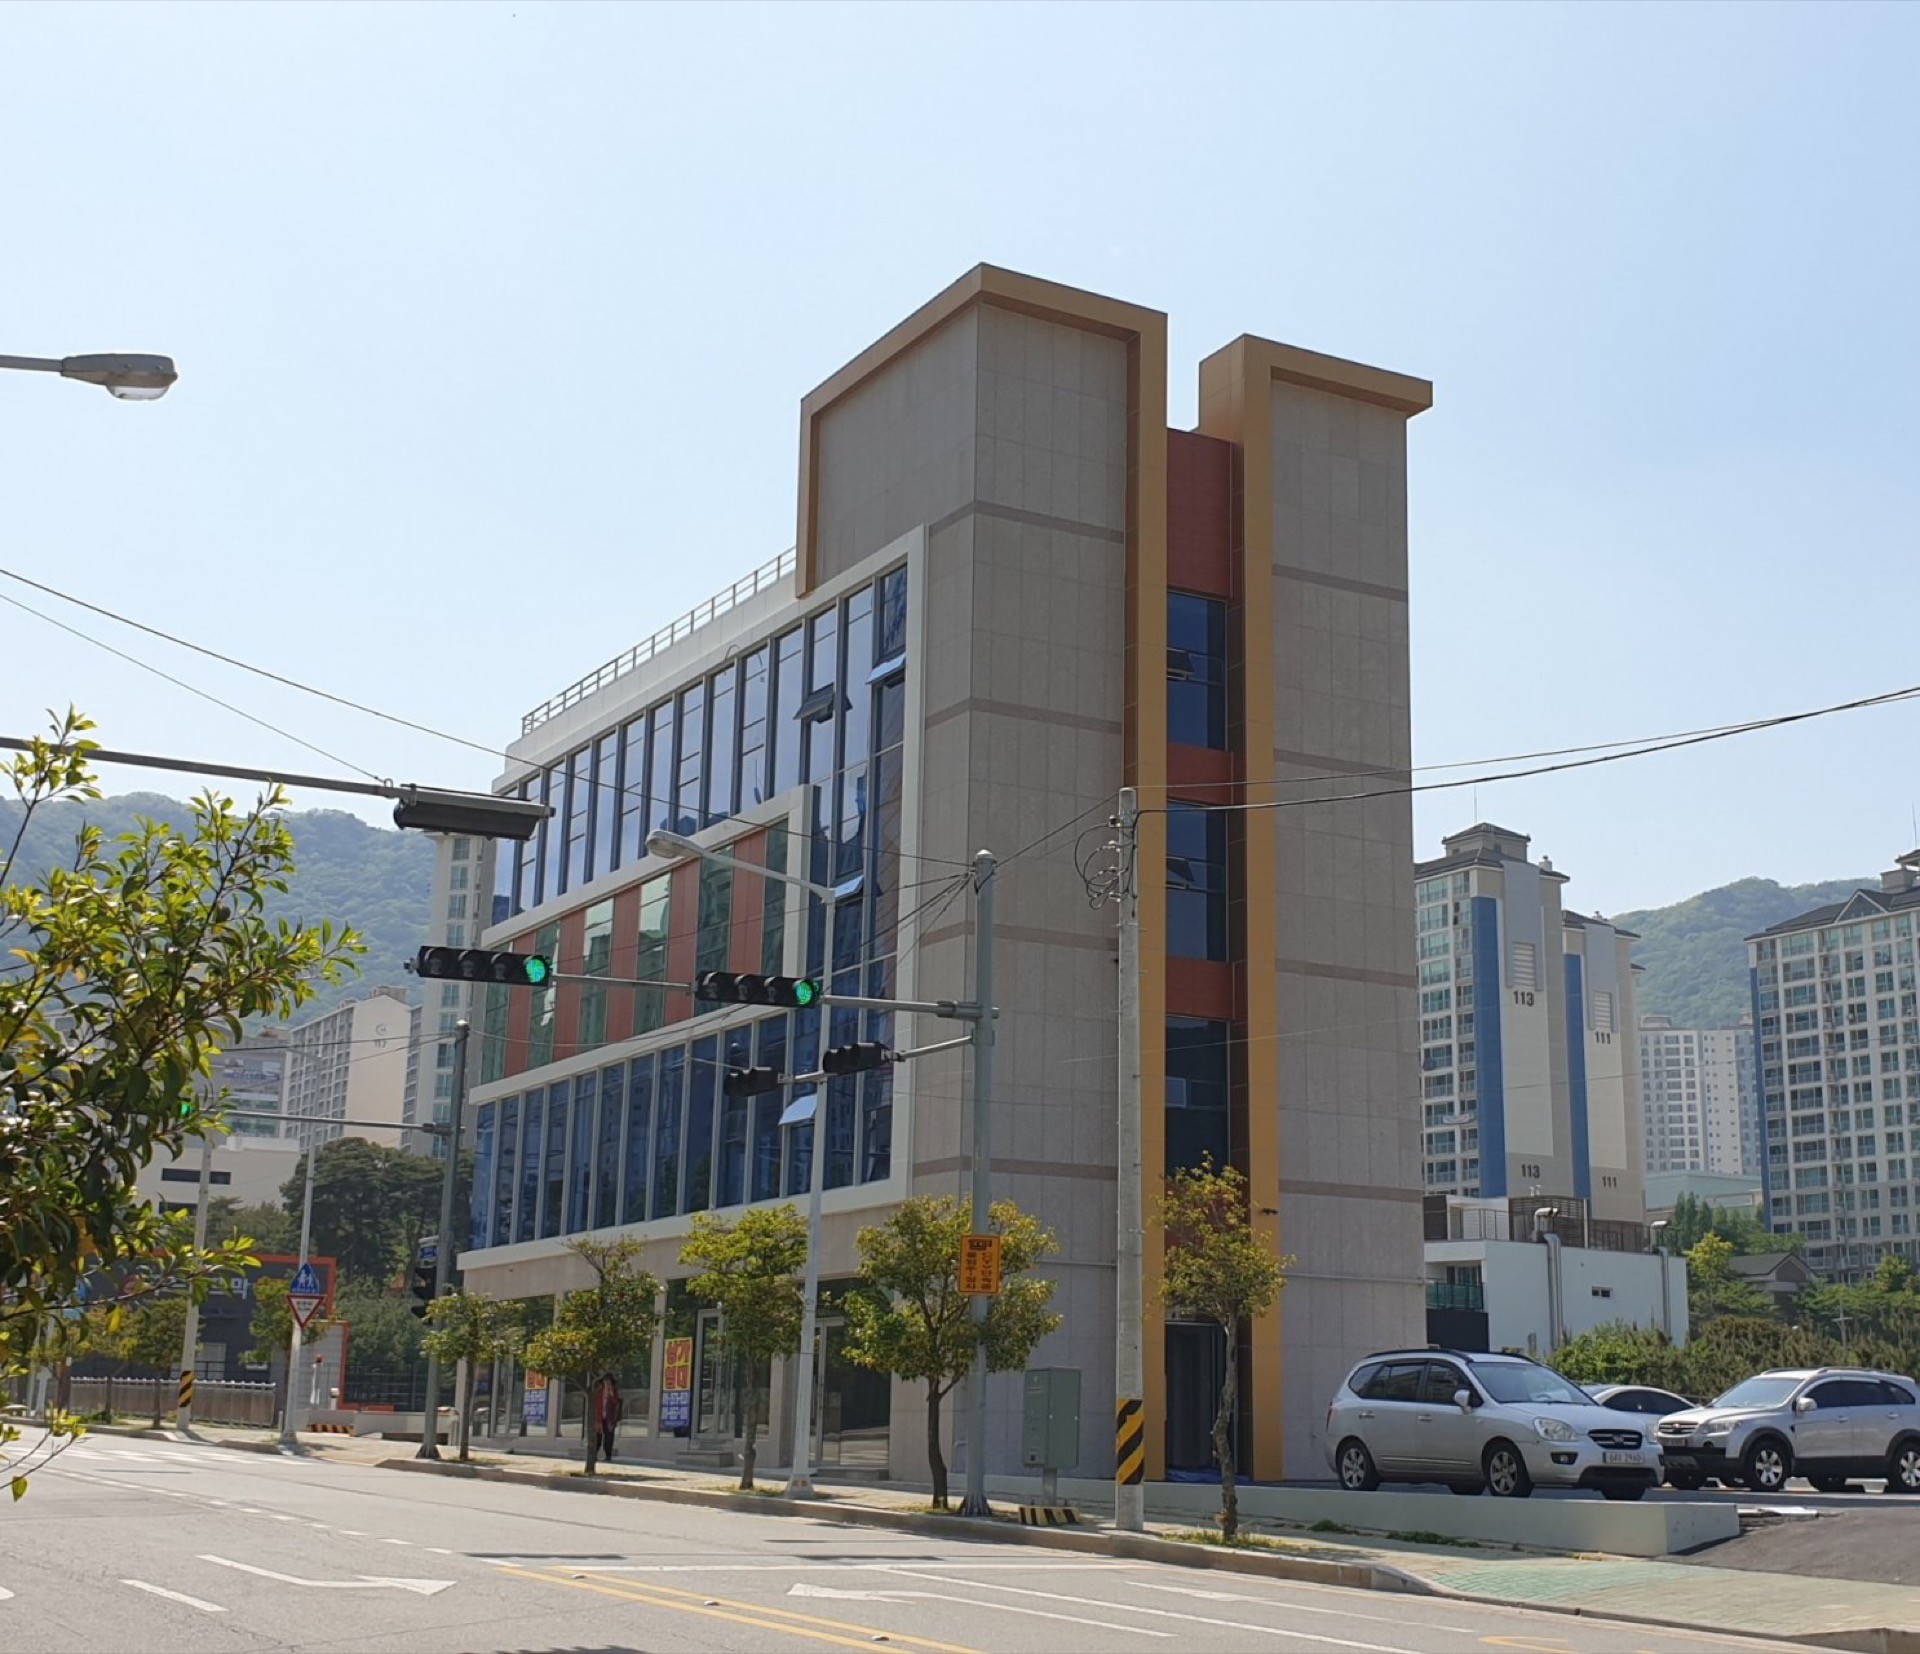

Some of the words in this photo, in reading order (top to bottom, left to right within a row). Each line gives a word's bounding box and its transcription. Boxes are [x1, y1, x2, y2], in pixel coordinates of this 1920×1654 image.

[1513, 990, 1535, 1007] 113
[1595, 1031, 1611, 1045] 111
[1521, 1163, 1540, 1178] 113
[1602, 1175, 1617, 1188] 111
